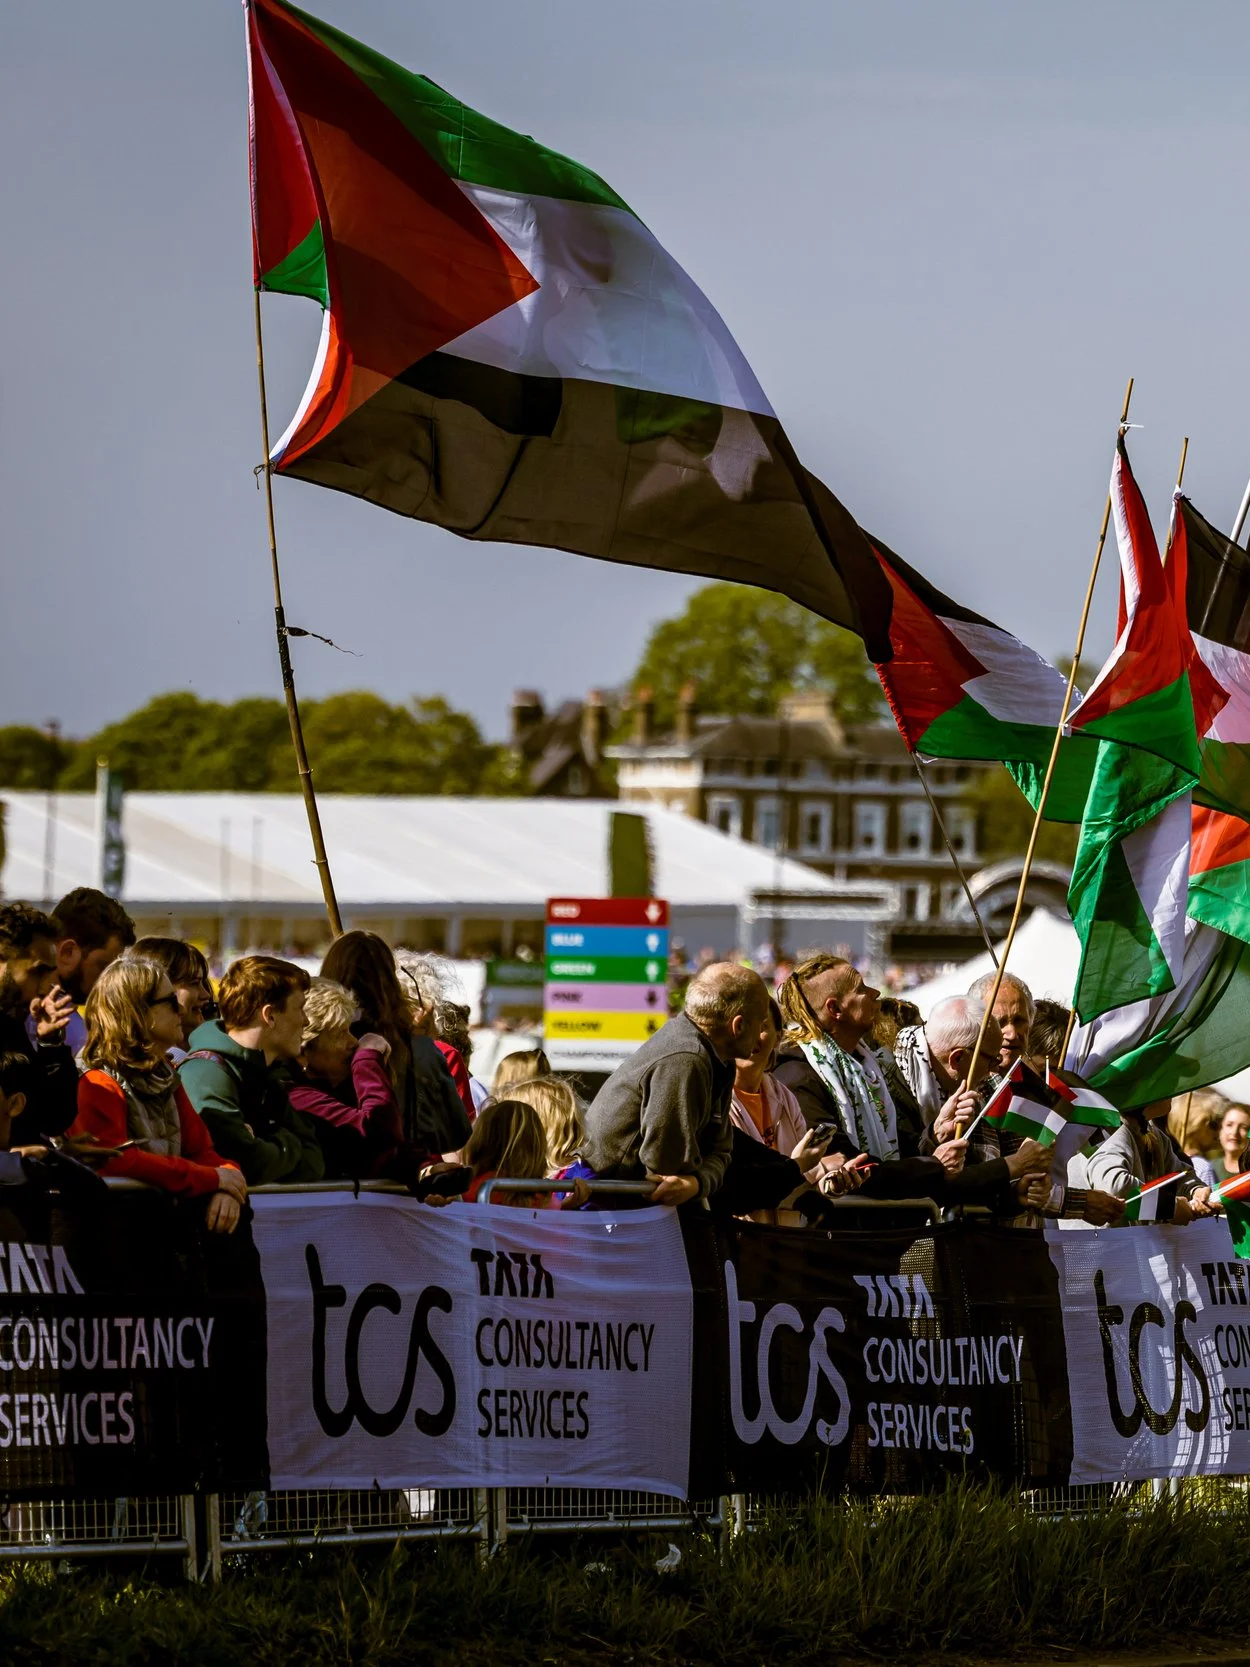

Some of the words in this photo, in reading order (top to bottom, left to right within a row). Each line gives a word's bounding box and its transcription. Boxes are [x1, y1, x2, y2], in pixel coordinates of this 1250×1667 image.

[551, 933, 584, 947] BLUE
[551, 962, 596, 976] GREEN
[470, 1248, 554, 1299] TATA
[853, 1273, 935, 1318] TATA
[0, 1316, 214, 1370] CONSULTANCY
[305, 1243, 456, 1437] tcs
[475, 1317, 655, 1372] CONSULTANCY
[724, 1259, 851, 1446] tcs
[862, 1335, 1024, 1385] CONSULTANCY
[1094, 1269, 1211, 1438] tcs
[0, 1391, 135, 1447] SERVICES
[477, 1388, 589, 1440] SERVICES
[867, 1402, 974, 1454] SERVICES
